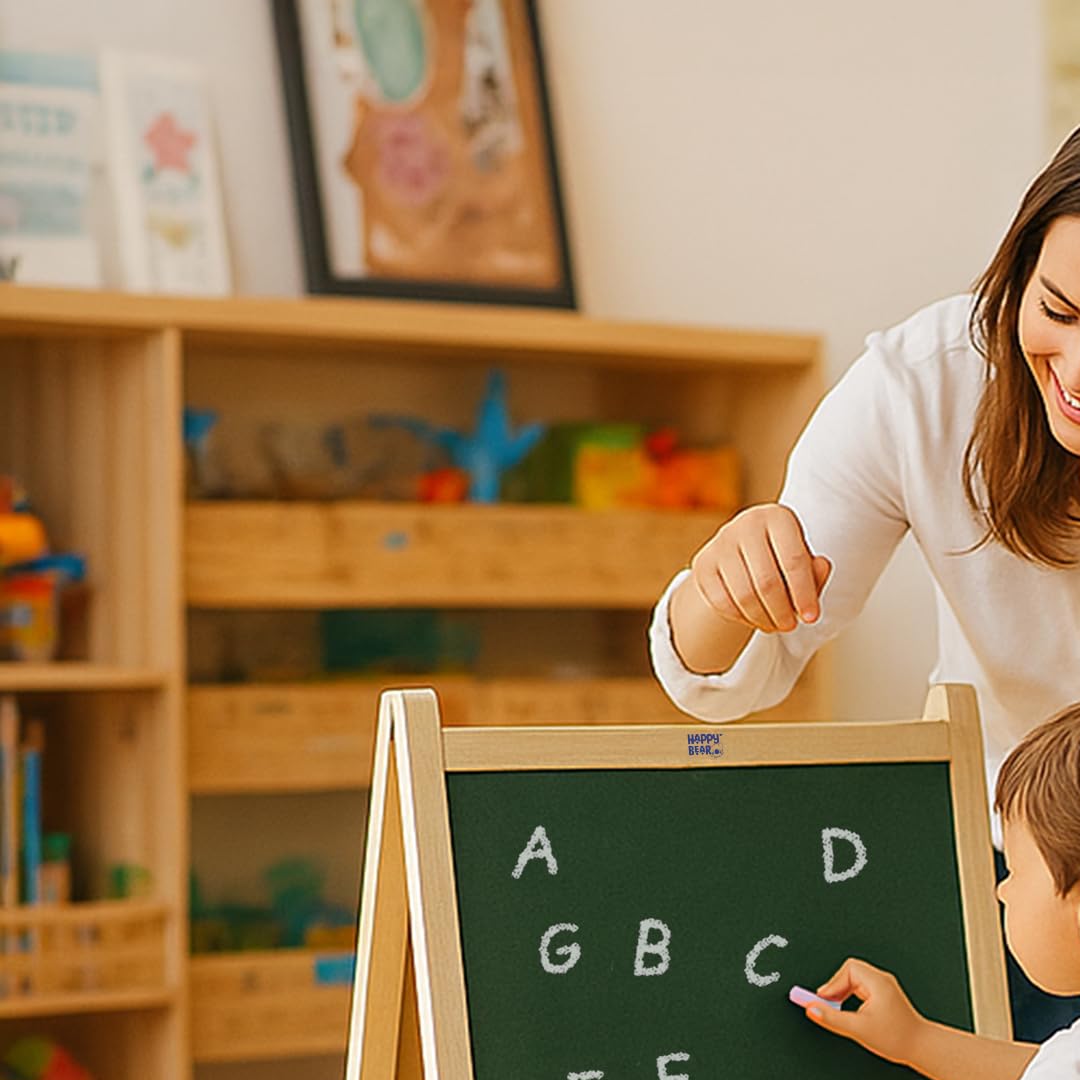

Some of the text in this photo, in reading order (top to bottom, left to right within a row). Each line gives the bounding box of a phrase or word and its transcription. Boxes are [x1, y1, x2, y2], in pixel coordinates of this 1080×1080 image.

[688, 733, 720, 745] HAPPY
[688, 745, 712, 756] BEAR
[511, 825, 559, 880] A
[822, 826, 868, 884] D
[538, 922, 582, 975] G
[633, 917, 672, 977] B
[744, 933, 789, 988] C
